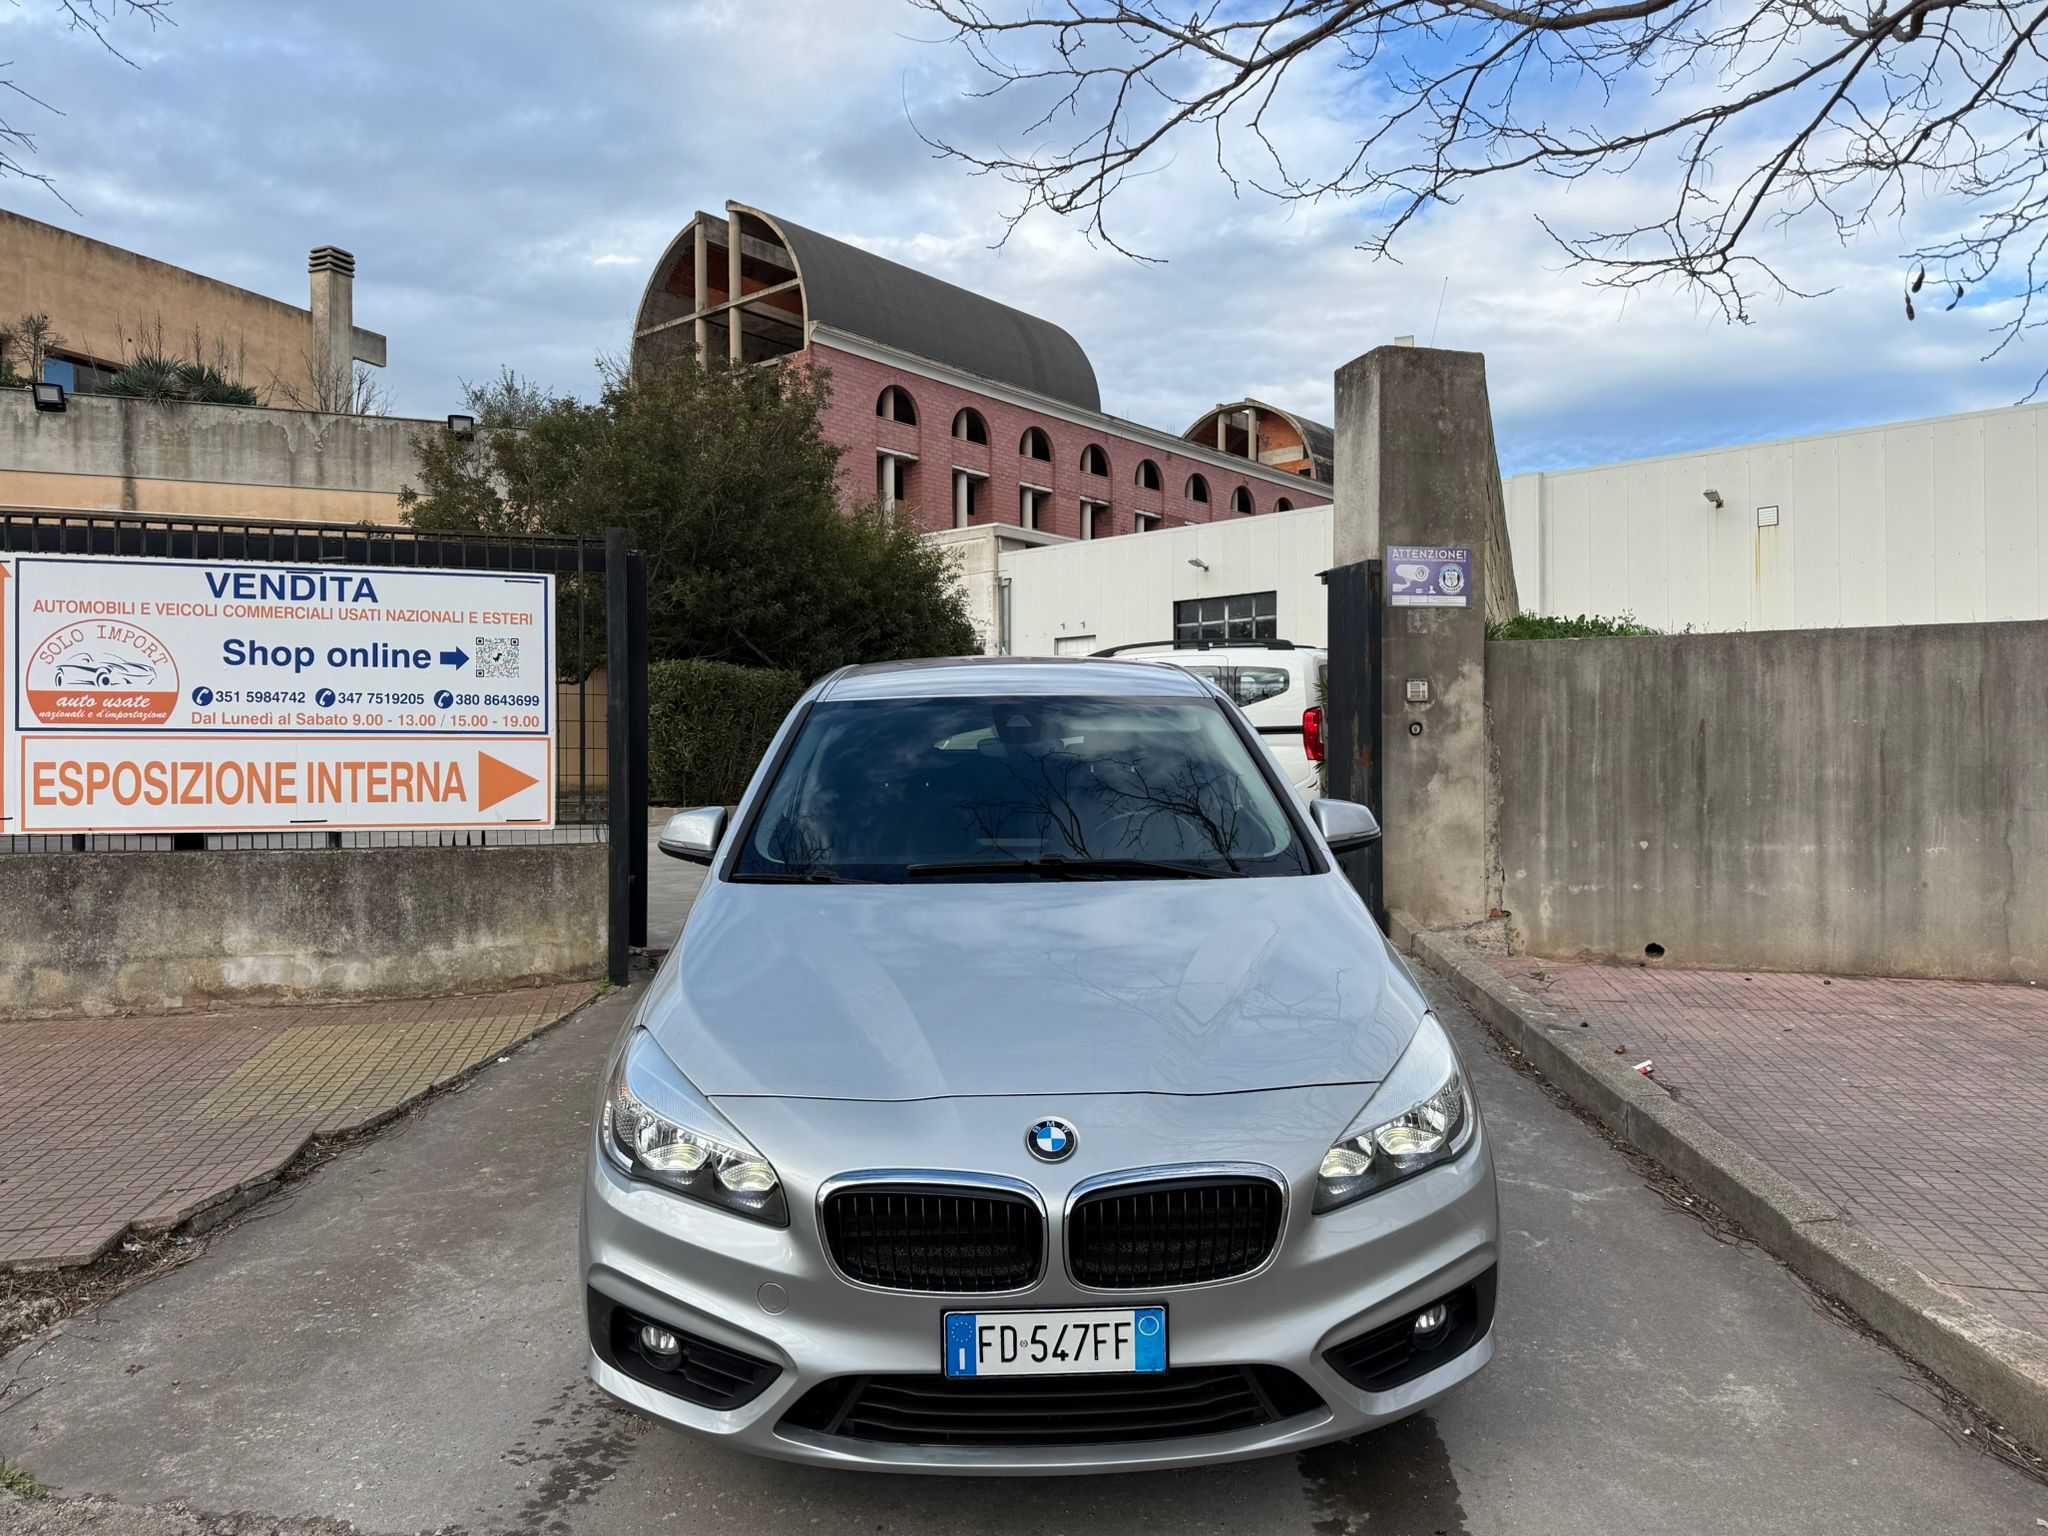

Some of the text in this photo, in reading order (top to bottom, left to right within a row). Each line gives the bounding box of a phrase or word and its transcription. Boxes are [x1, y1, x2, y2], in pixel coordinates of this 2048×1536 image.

[1392, 549, 1467, 561] ATTENZIONE!
[205, 572, 378, 603] VENDITA
[33, 600, 533, 625] AUTOMOBILI E VEICOLI COMMERCIALI USATI NAZIONALI E ESTERI
[40, 625, 168, 665] SOLO IMPORT
[223, 639, 431, 673] Shop online
[56, 694, 151, 708] auto usate
[215, 691, 305, 703] 351 5984742
[338, 692, 424, 705] 347 7519205
[456, 694, 539, 706] 380 8643699
[39, 709, 85, 720] nazionali
[96, 709, 167, 721] d'importazione
[191, 712, 216, 725] Dal
[222, 711, 273, 725] Lunedì
[278, 712, 291, 726] al
[296, 713, 348, 726] Sabato
[352, 714, 383, 726] 9.00
[398, 714, 435, 727] 13.00
[440, 714, 446, 727] /
[450, 714, 488, 727] 15.00
[502, 715, 539, 727] 19.00
[33, 760, 467, 806] ESPOSIZIONE INTERNA
[1033, 1120, 1071, 1133] BMW
